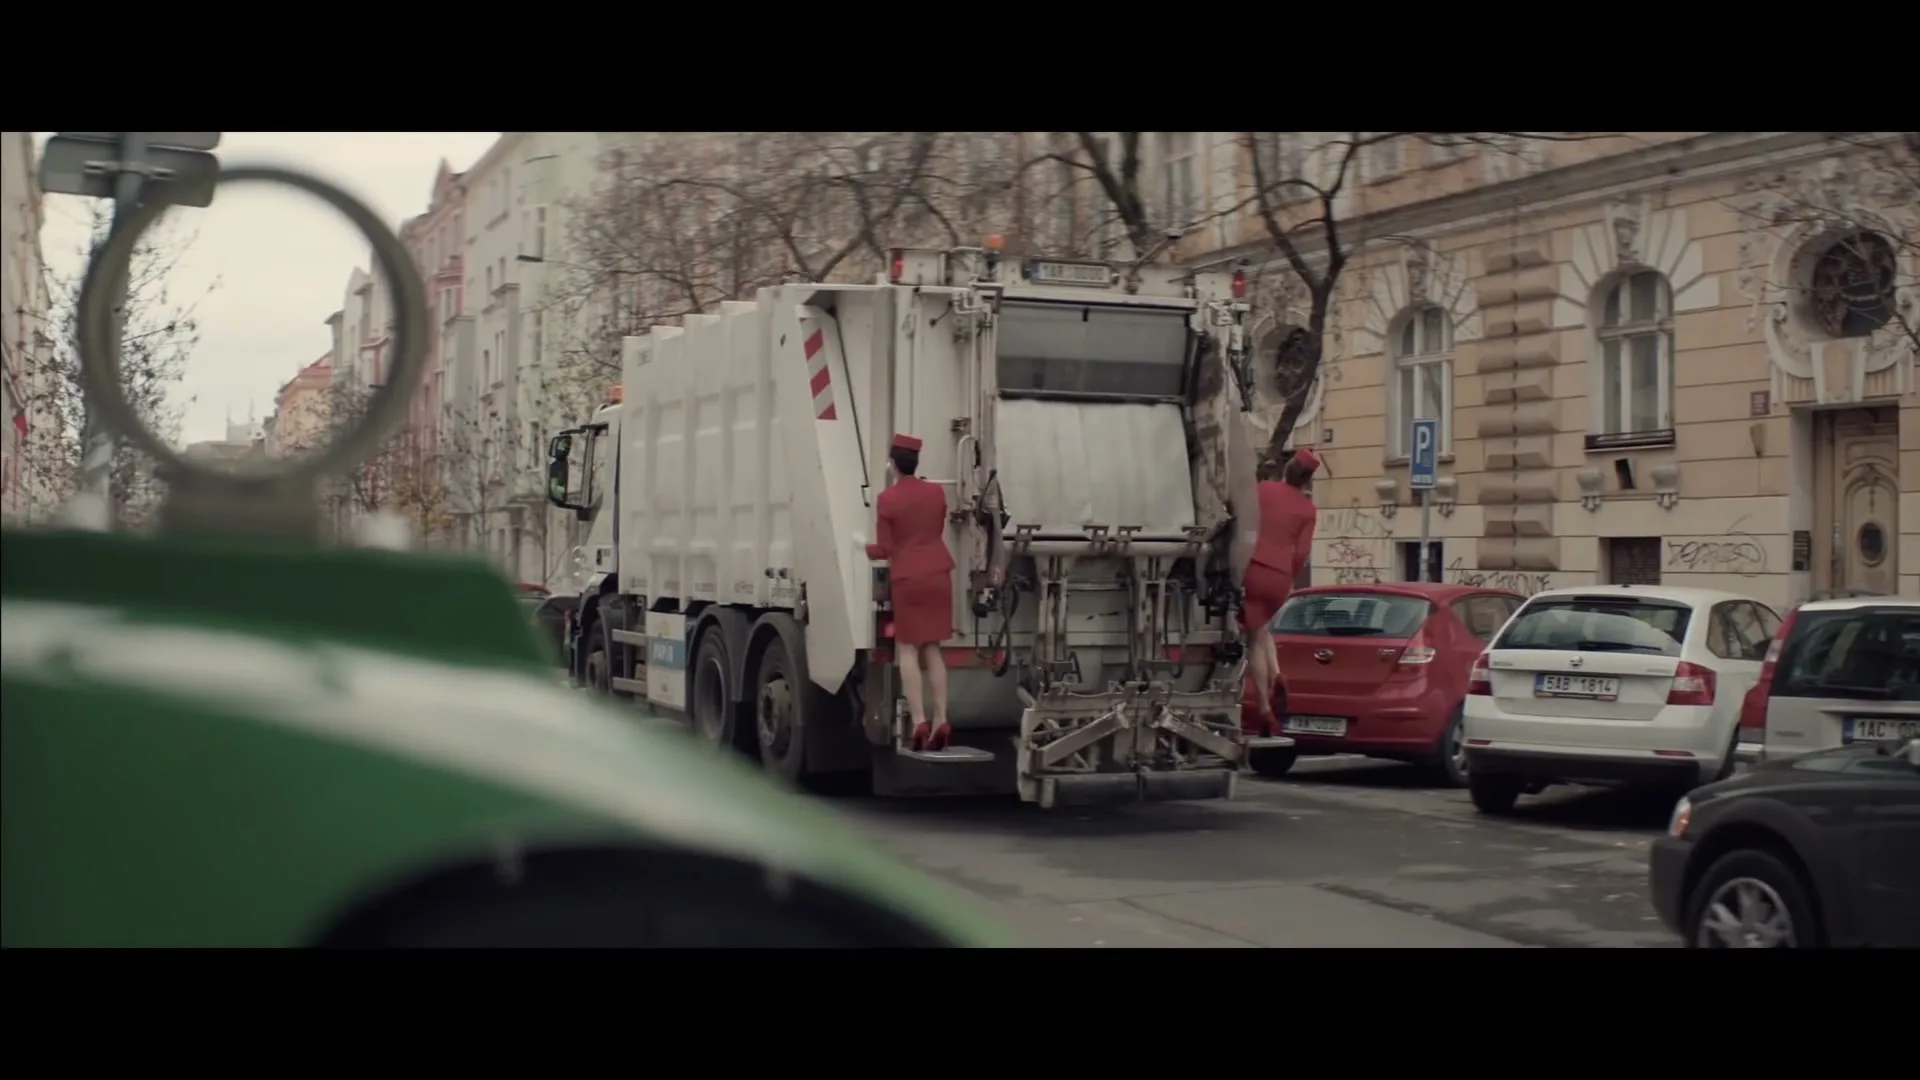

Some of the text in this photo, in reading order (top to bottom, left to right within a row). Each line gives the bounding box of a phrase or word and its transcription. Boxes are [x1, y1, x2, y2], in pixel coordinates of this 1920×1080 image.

[1416, 426, 1430, 464] P
[1580, 678, 1612, 693] 1814
[1859, 720, 1885, 738] 1AC
